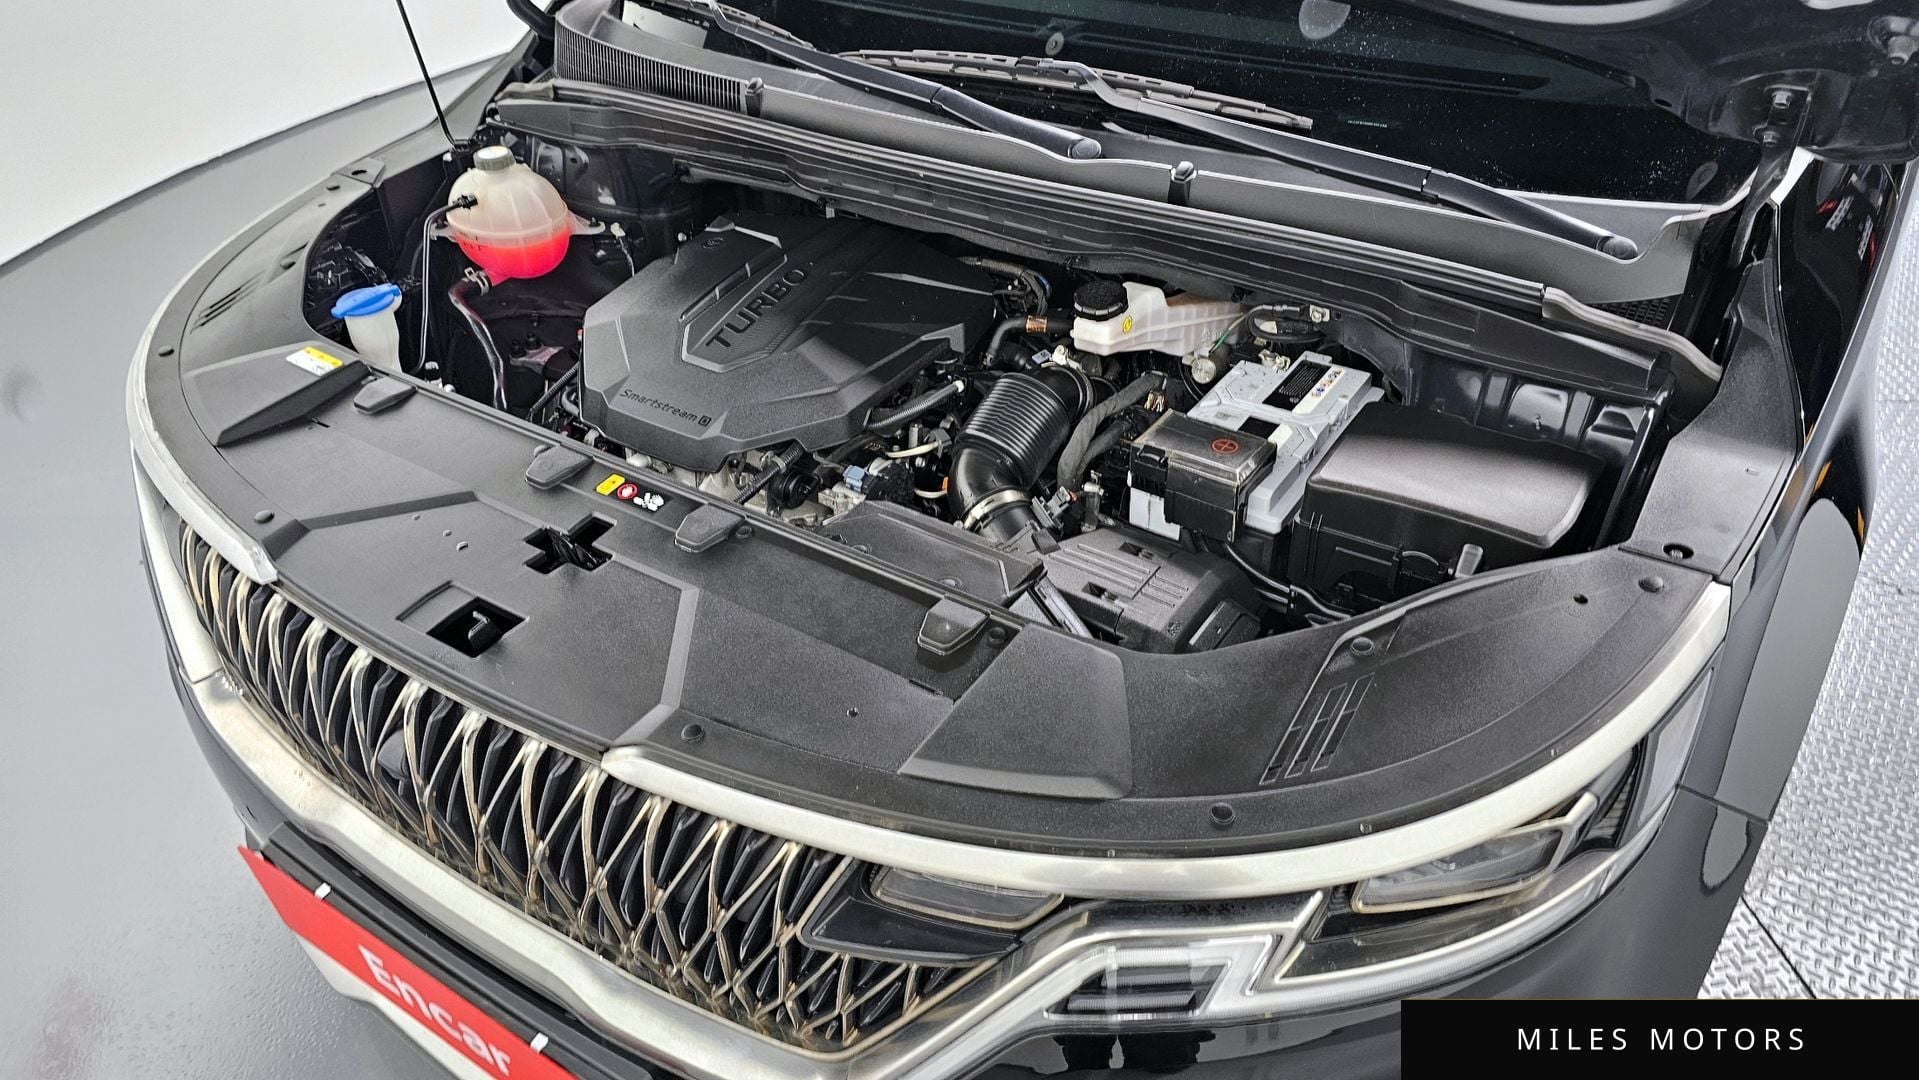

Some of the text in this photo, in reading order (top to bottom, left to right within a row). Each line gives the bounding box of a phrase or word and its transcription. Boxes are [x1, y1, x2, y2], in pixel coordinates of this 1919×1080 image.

[705, 269, 806, 348] TURBO
[620, 388, 698, 422] Smartstream
[358, 943, 511, 1078] Encar
